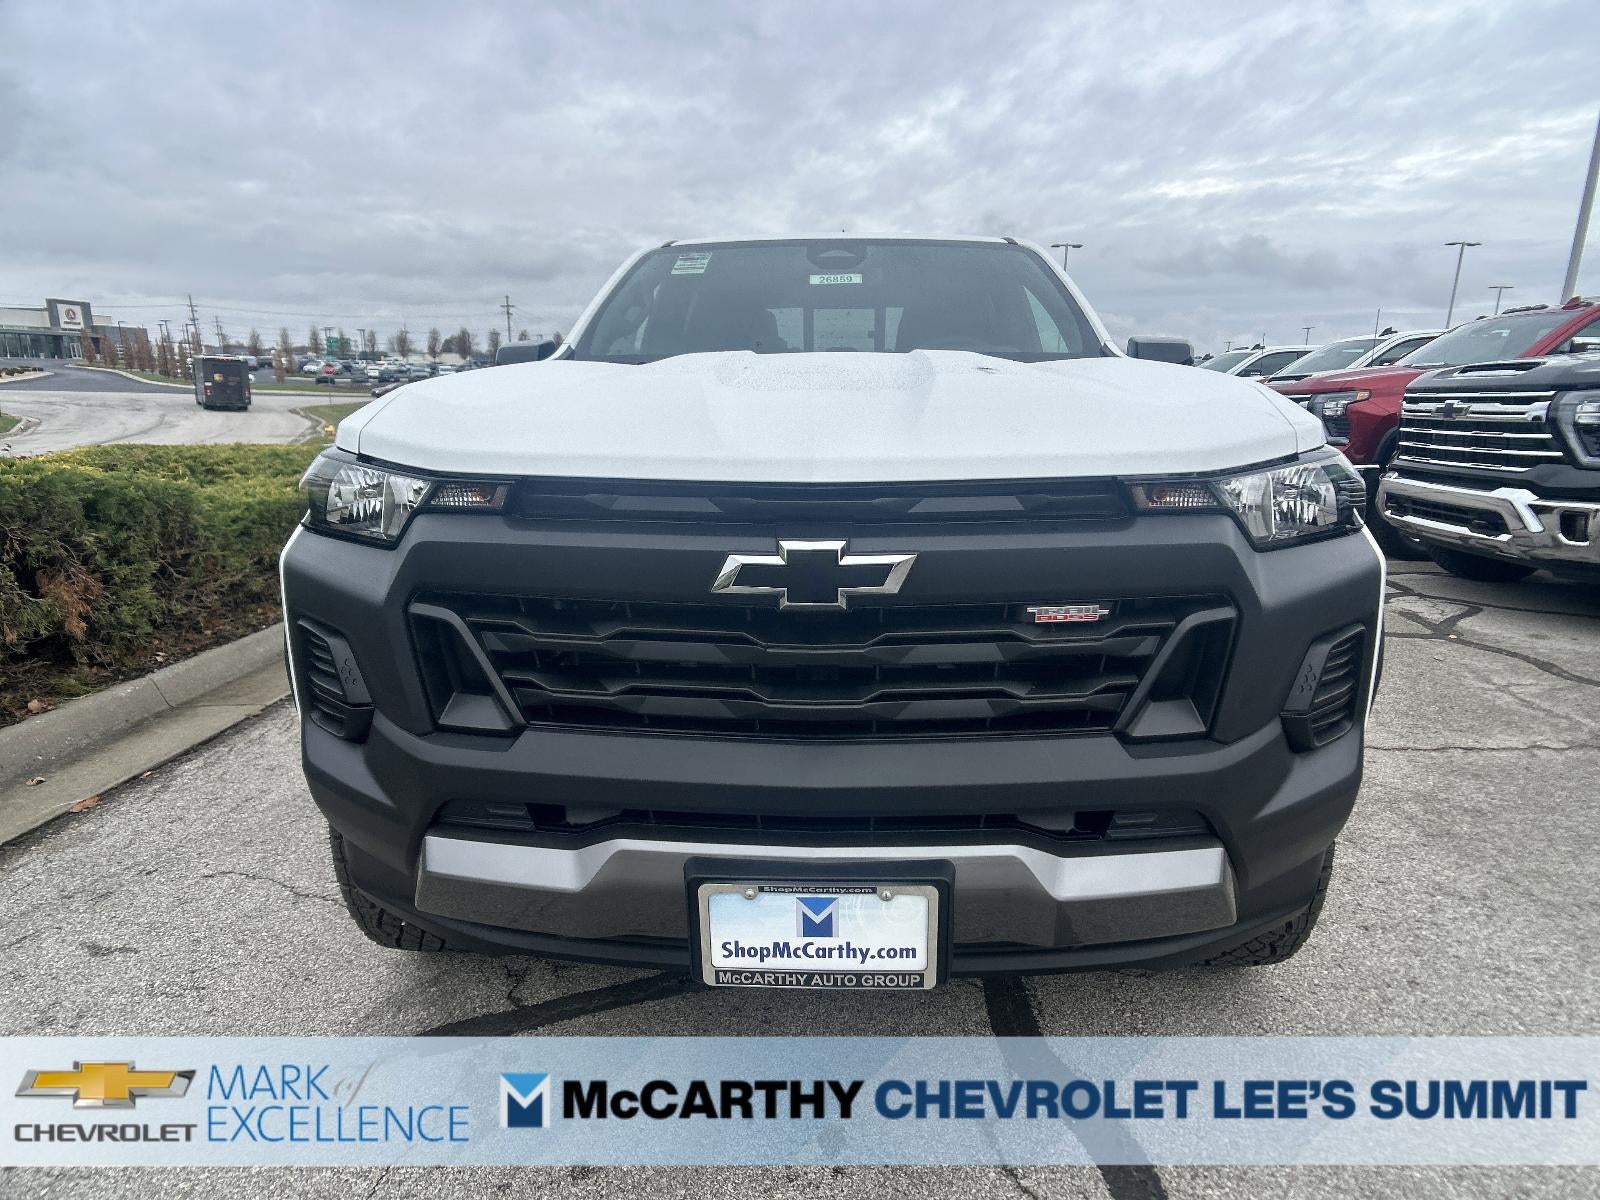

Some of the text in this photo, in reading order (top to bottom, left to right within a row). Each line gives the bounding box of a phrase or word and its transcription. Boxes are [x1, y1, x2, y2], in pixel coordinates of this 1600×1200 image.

[818, 275, 853, 284] 26859
[763, 886, 874, 894] ShopMcCarthy.com
[721, 940, 917, 964] ShopMcCarthy.com
[718, 971, 921, 988] McCARTHY AUTO GROUP
